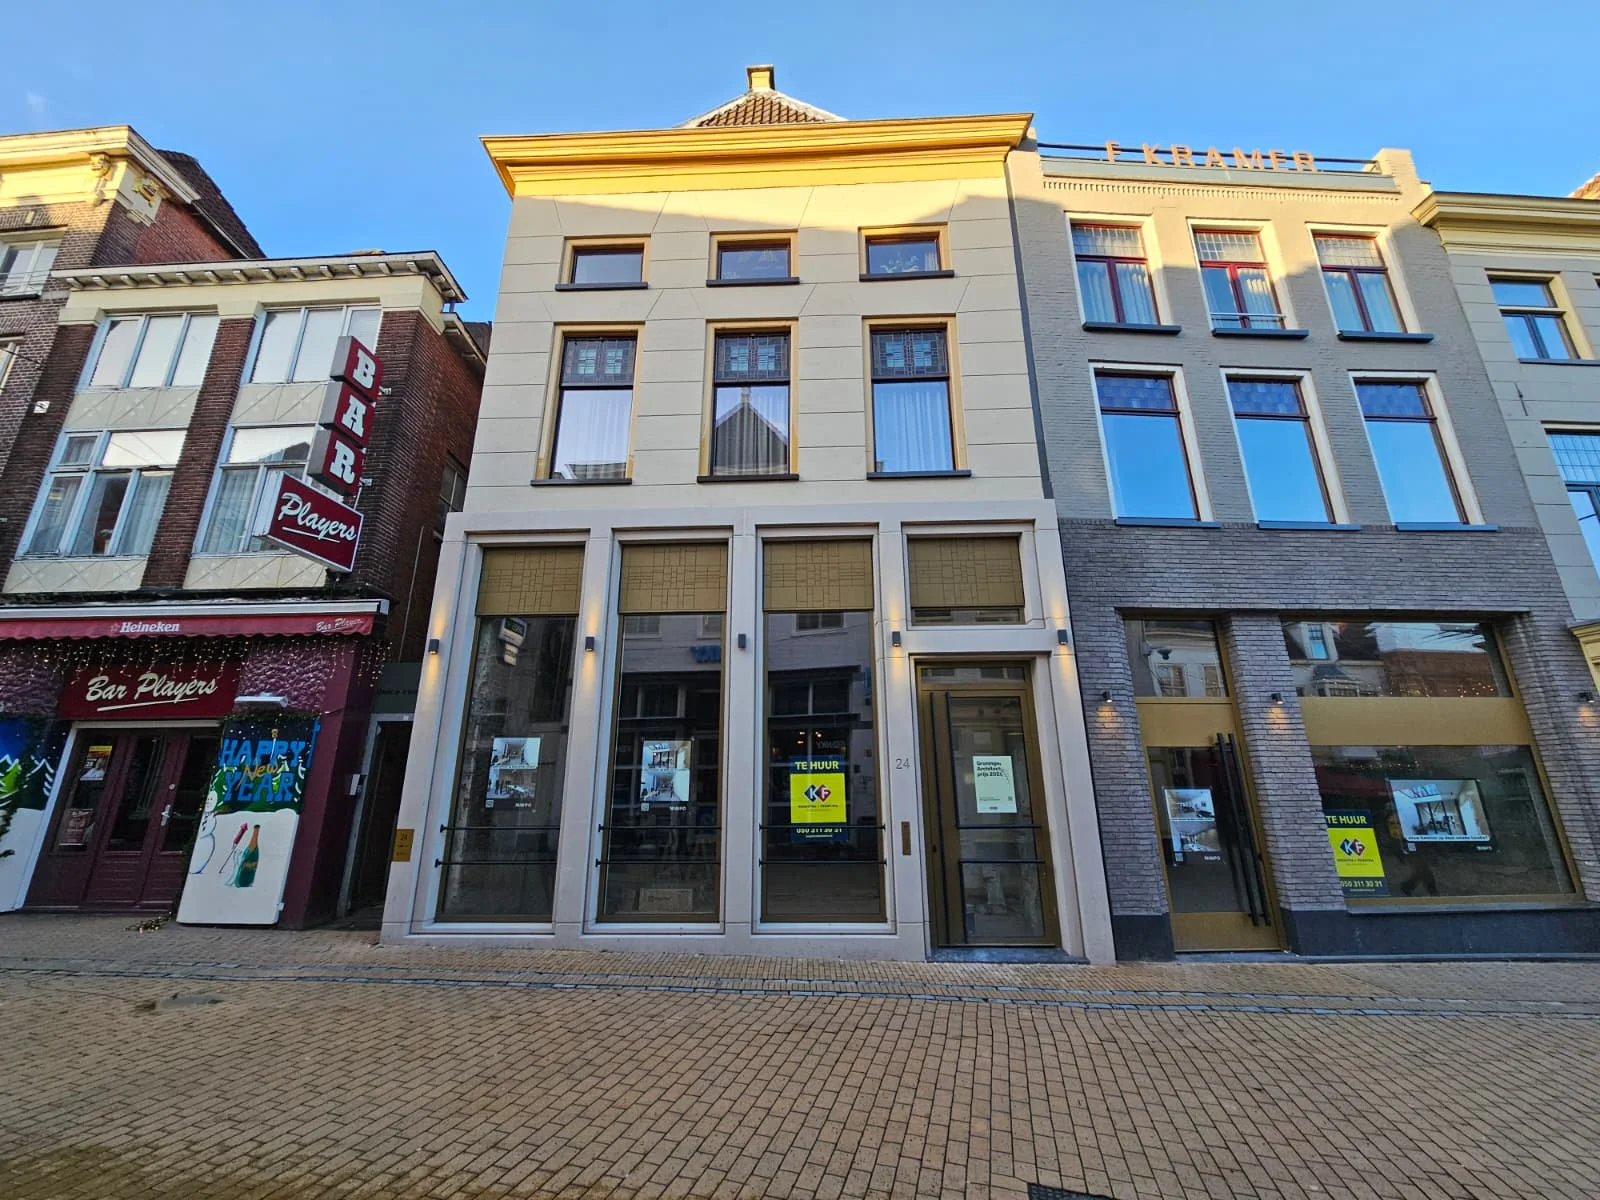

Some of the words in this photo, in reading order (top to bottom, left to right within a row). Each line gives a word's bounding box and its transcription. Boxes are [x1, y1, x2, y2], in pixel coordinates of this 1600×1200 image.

[1142, 143, 1318, 172] KRAMER
[330, 349, 377, 485] BAR
[277, 492, 358, 542] Players
[119, 621, 181, 634] Heineken
[315, 621, 332, 632] Bar
[85, 675, 128, 702] Bar
[133, 672, 219, 704] Players
[218, 738, 306, 768] HAPPY
[795, 761, 808, 770] TE
[809, 760, 840, 770] HUUR
[895, 758, 911, 770] 24
[222, 771, 295, 803] YEAR
[1325, 815, 1338, 824] TE
[1339, 815, 1368, 825] HUUR
